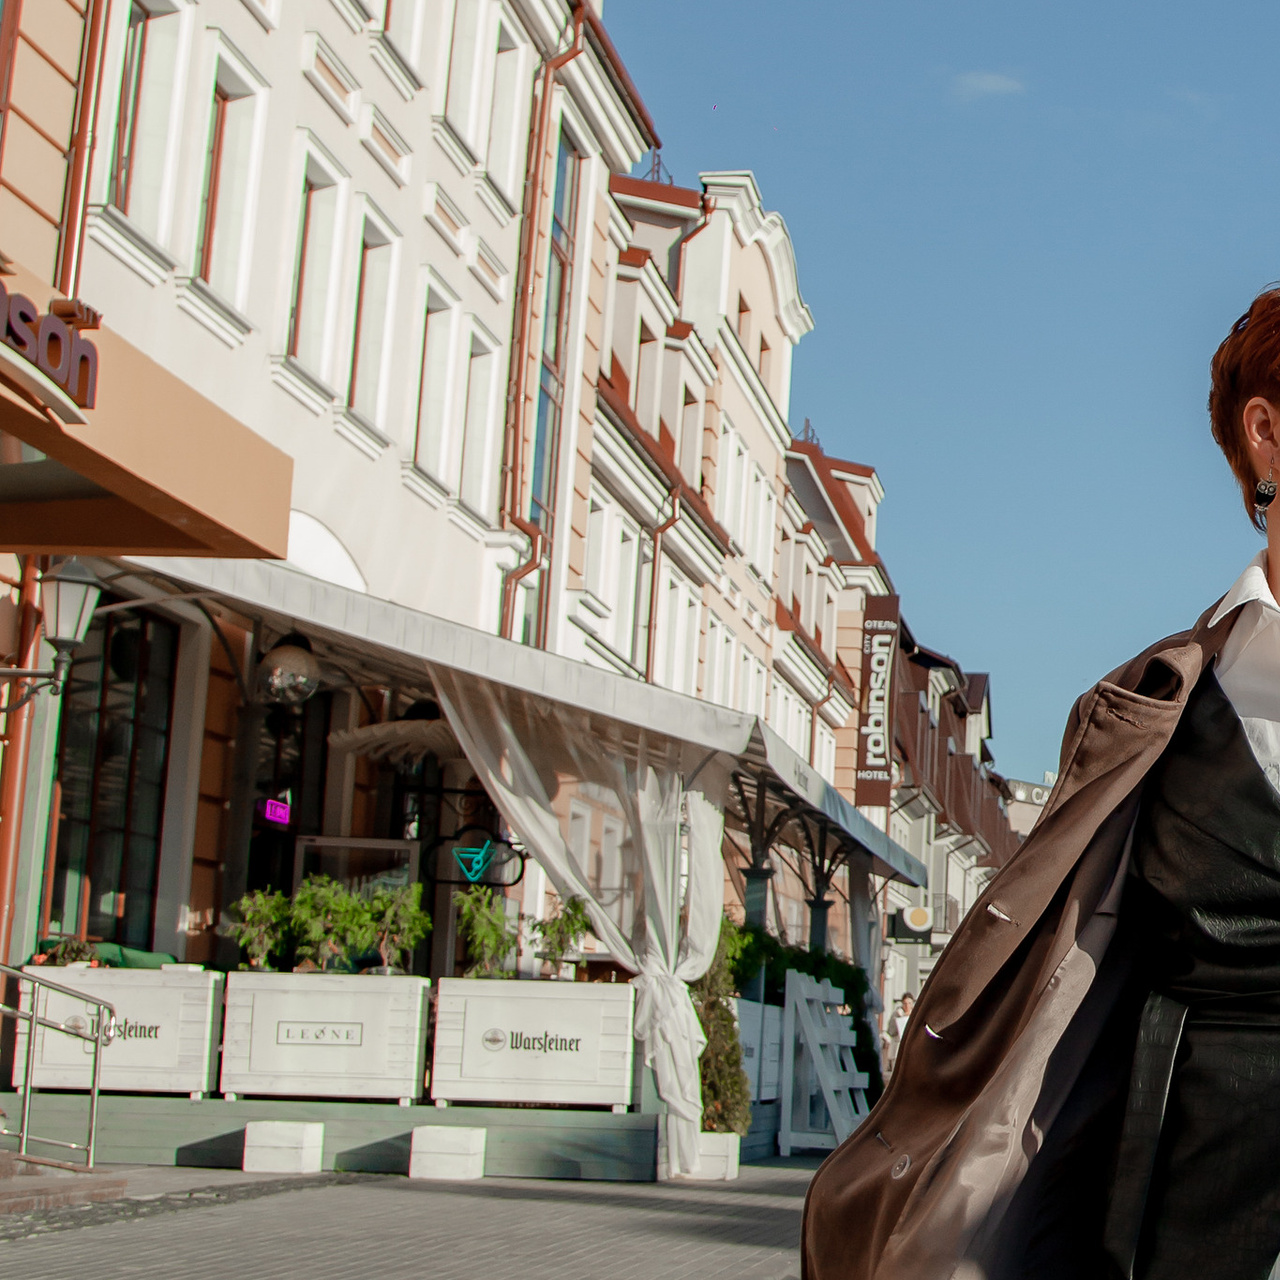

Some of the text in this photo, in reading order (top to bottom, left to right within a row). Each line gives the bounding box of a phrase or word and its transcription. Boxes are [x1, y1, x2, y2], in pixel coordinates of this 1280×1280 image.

[861, 634, 892, 767] robinson
[857, 770, 891, 780] HOTEL
[510, 1030, 581, 1053] Warsteiner
